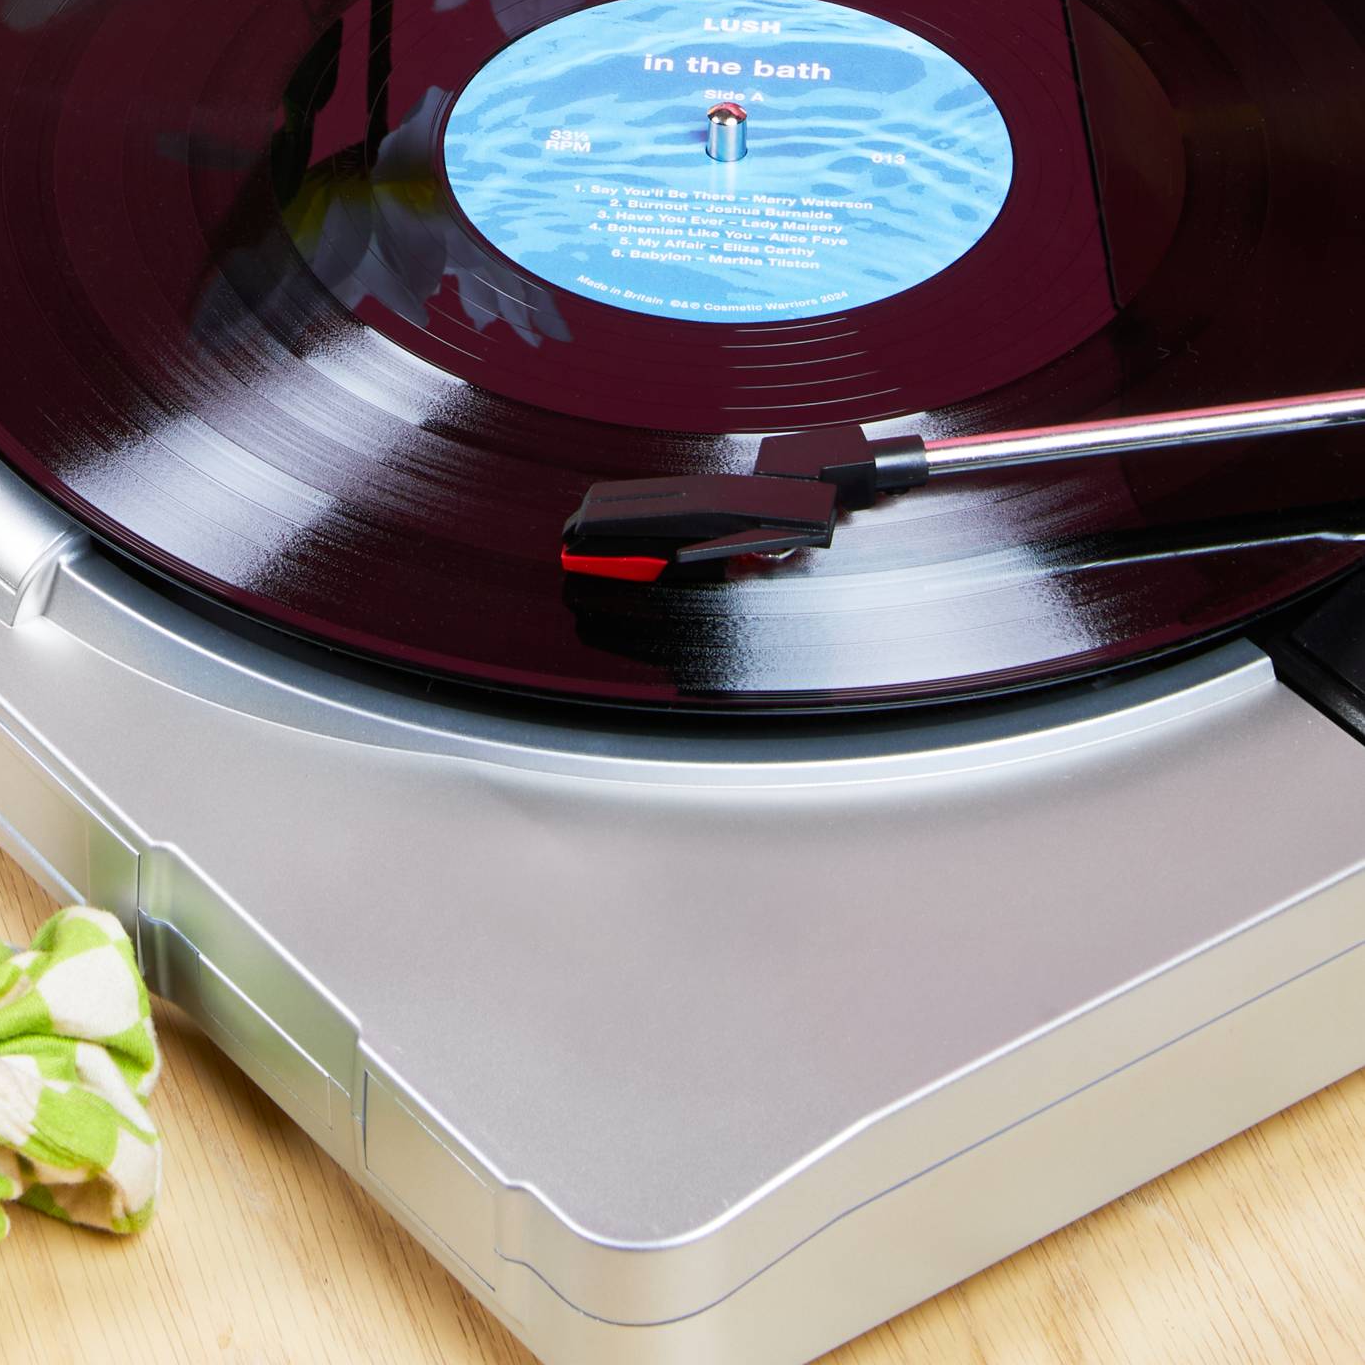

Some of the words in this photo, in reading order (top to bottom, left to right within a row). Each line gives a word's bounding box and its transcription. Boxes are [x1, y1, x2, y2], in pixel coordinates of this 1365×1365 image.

[703, 17, 781, 34] LUSH
[644, 53, 674, 72] in
[686, 56, 742, 75] the
[753, 59, 832, 81] bath
[704, 89, 745, 101] Side
[750, 91, 765, 102] A
[546, 139, 591, 153] RPM
[871, 152, 906, 165] 013
[574, 184, 585, 193] 1.
[590, 184, 619, 196] Say
[623, 186, 663, 198] You'll
[668, 189, 688, 199] Be
[693, 190, 735, 202] There
[752, 194, 797, 207] Marry
[801, 197, 874, 210] Waterson
[610, 198, 623, 208] 2.
[628, 199, 690, 212] Burnout
[705, 204, 760, 216] Joshua
[765, 207, 833, 220] Burnside
[597, 210, 610, 219] 3.
[615, 211, 654, 223] Have
[658, 213, 685, 224] You
[691, 215, 725, 226] Ever
[741, 219, 779, 231] Lady
[783, 221, 843, 234] Maisery
[589, 222, 602, 231] 4.
[607, 223, 683, 236] Bohemian
[688, 228, 720, 239] Like
[725, 230, 753, 241] You
[769, 232, 808, 244] Alice
[811, 235, 849, 247] Faye
[619, 236, 632, 246] 5.
[637, 237, 660, 249] My
[664, 238, 707, 251] Affair
[723, 242, 760, 254] Eliza
[764, 244, 816, 258] Carthy
[611, 248, 625, 258] 6.
[630, 249, 692, 262] Babylon
[708, 254, 763, 267] Martha
[768, 257, 821, 270] Tilston
[577, 274, 609, 291] Made
[610, 287, 621, 296] in
[623, 289, 665, 306] Britain
[704, 302, 763, 312] Cosmetic
[765, 298, 819, 311] Warriors
[820, 290, 850, 304] 2024
